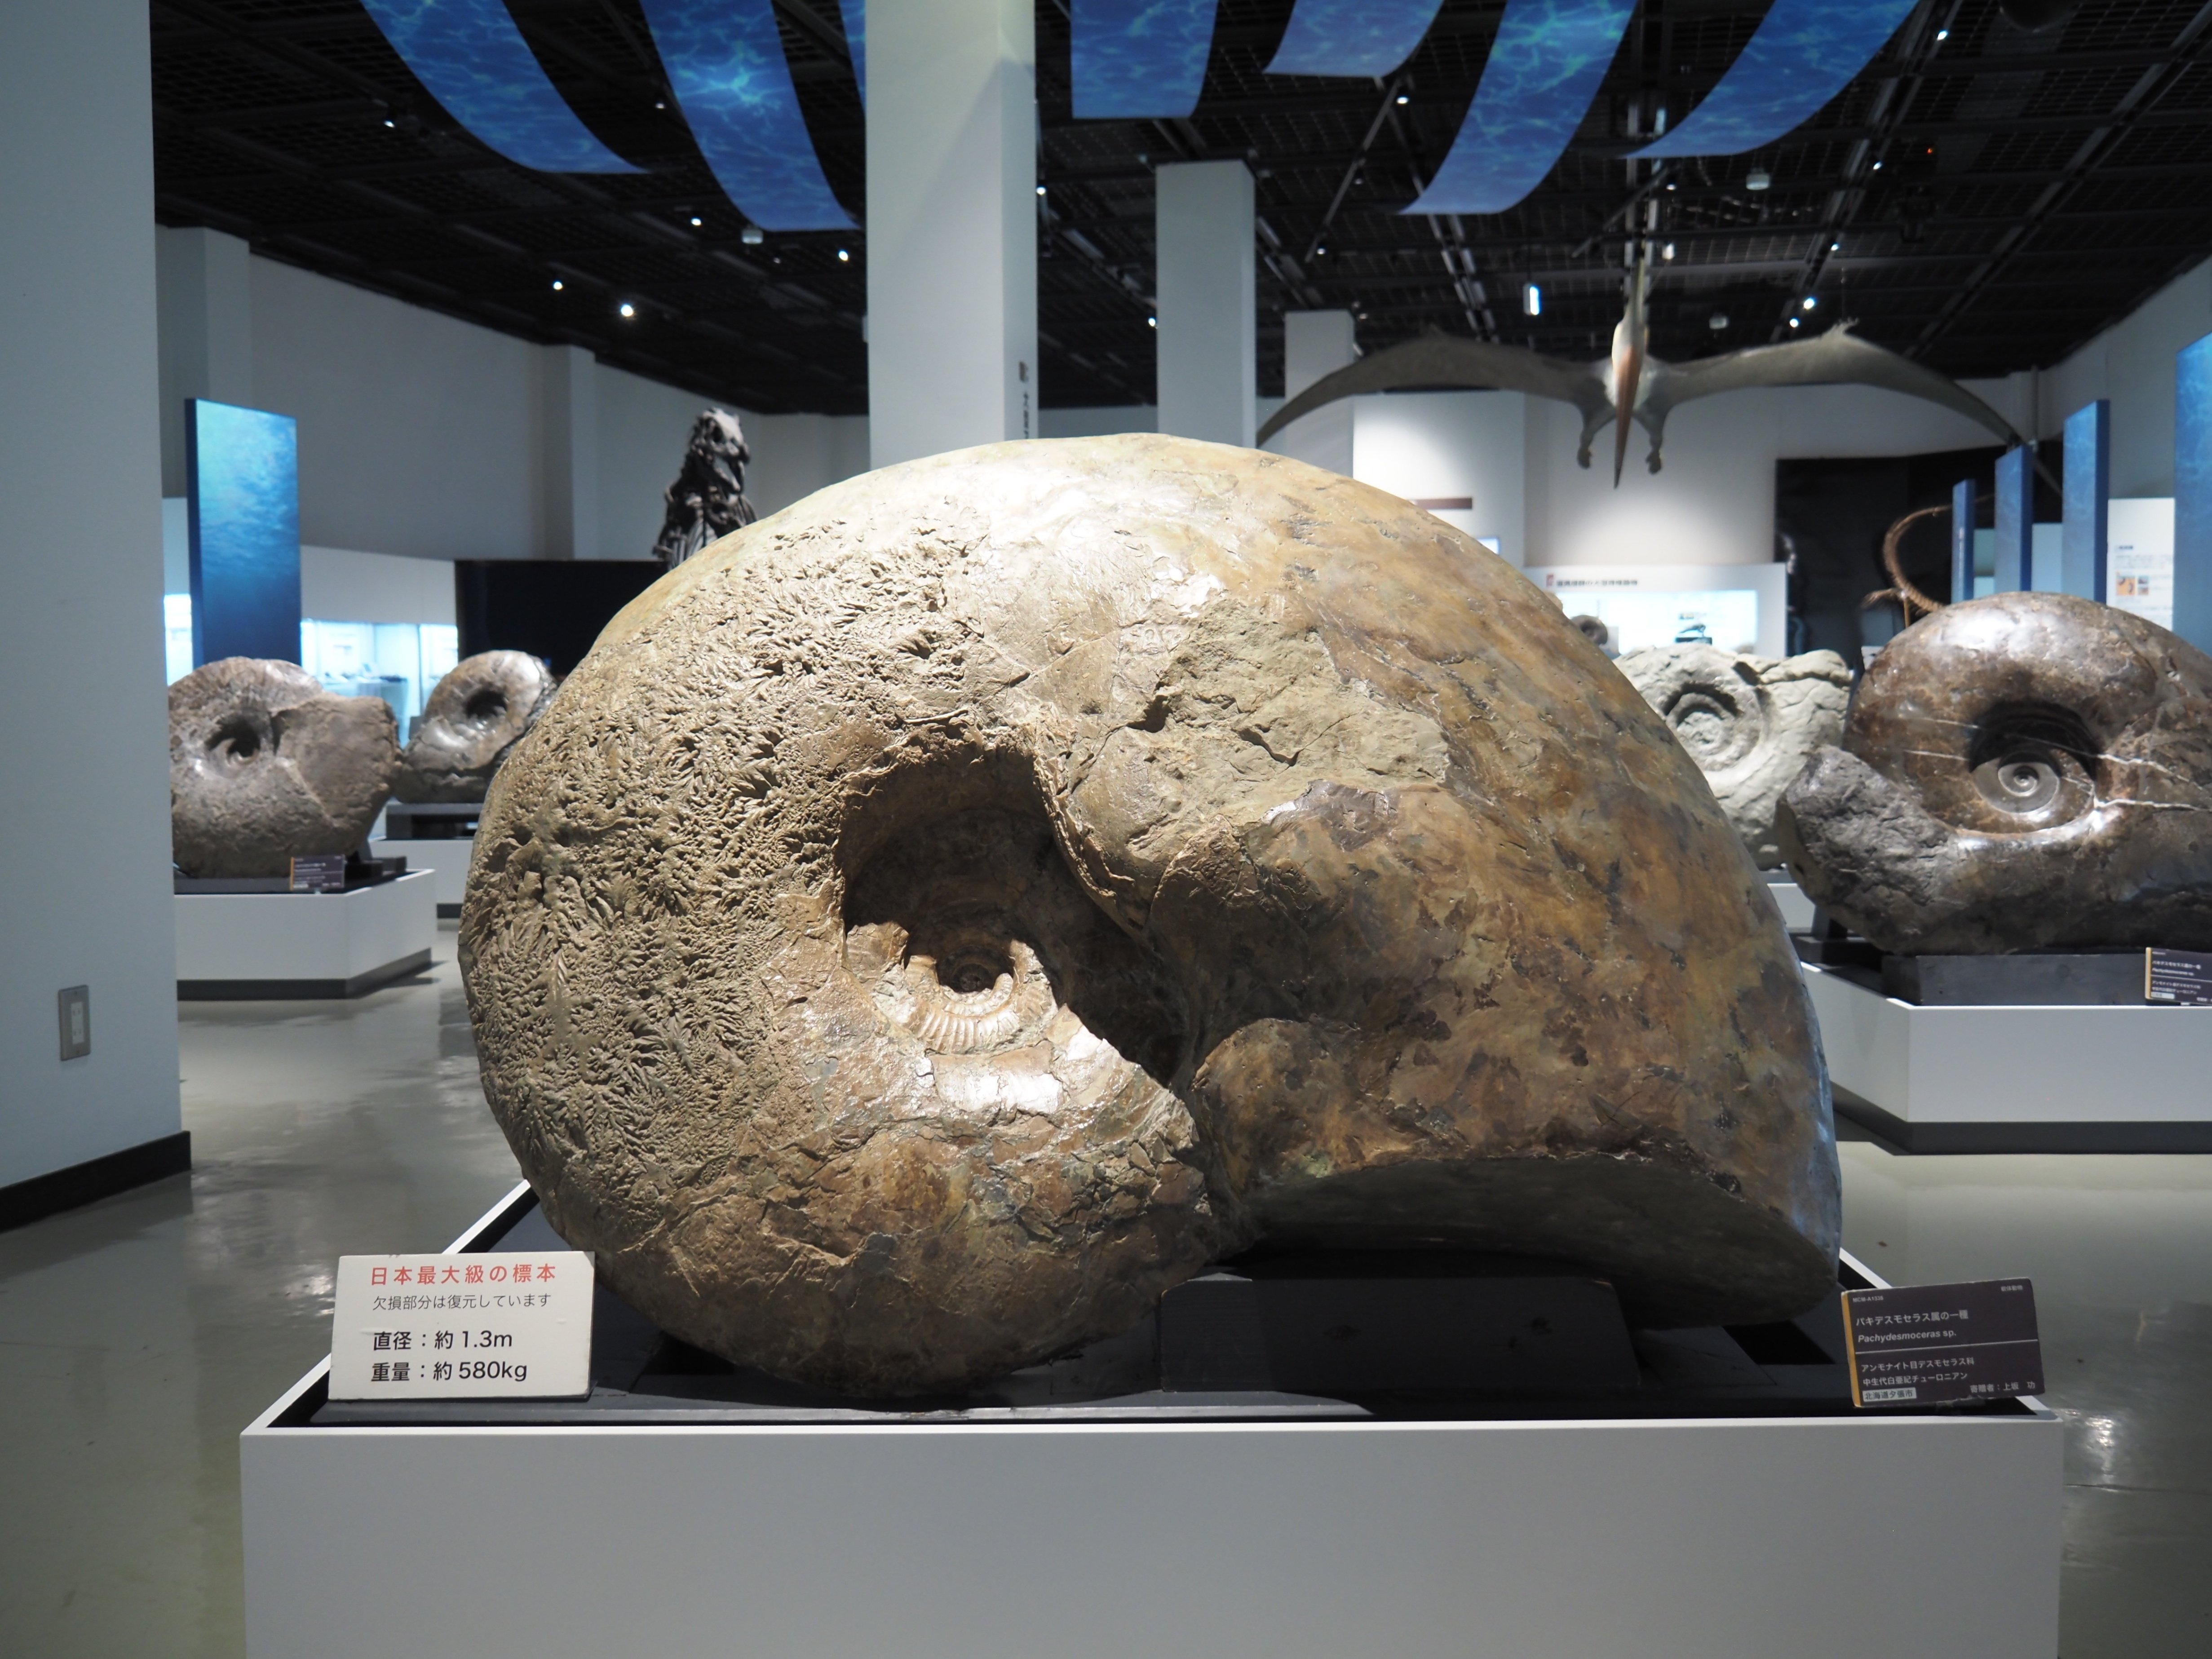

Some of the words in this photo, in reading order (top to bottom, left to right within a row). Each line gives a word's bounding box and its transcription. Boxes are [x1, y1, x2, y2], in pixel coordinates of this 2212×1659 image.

[372, 1264, 555, 1285] 日本最大級の標本
[373, 1293, 551, 1310] 欠損部分は復元しています
[1858, 1332, 1940, 1343] Pachydesmoceras
[1862, 1357, 1974, 1372] アンモナイト目デスモセラス科
[1863, 1372, 1967, 1386] 中生代白亜紀チューロニアン
[1864, 1390, 1914, 1400] 北海道夕張市
